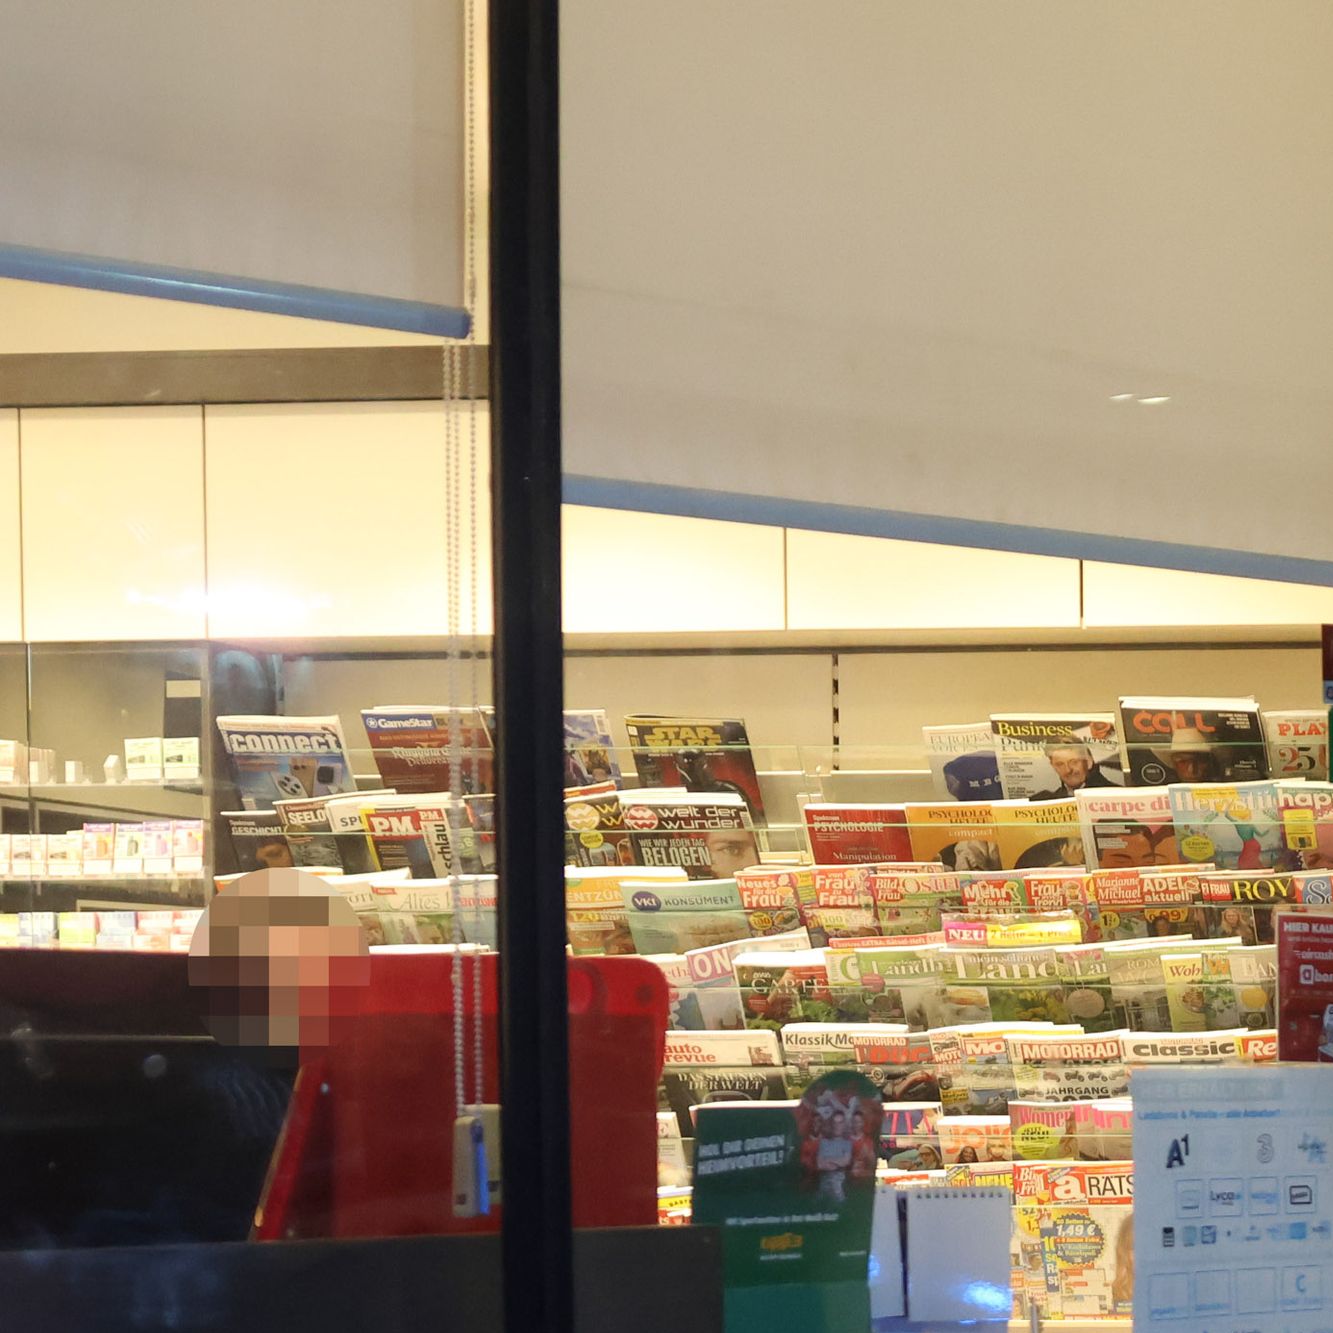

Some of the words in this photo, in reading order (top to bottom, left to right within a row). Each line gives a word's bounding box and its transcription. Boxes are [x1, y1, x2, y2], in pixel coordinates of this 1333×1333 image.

[377, 717, 434, 730] GameStar
[996, 720, 1074, 738] Business
[651, 726, 718, 741] STAR
[228, 731, 343, 755] connect
[658, 805, 701, 818] welt
[705, 805, 738, 818] der
[1088, 797, 1146, 816] carpe
[661, 818, 740, 830] wunder
[814, 822, 884, 833] PSYCHOLOGIE
[832, 850, 897, 861] Manipulation
[815, 874, 856, 890] Frau
[1142, 877, 1185, 892] ADEL
[1098, 887, 1142, 899] Michael
[1210, 883, 1230, 896] FRAU
[664, 895, 736, 906] KONSUMENT
[743, 891, 783, 908] Frau
[1143, 891, 1189, 903] aktuell
[948, 929, 985, 940] NEU
[663, 1042, 703, 1054] auto
[852, 1036, 907, 1047] MOTORRAD
[1021, 1041, 1121, 1060] MOTORRAD
[1132, 1040, 1236, 1057] Classic
[664, 1053, 717, 1063] revue
[1044, 1086, 1110, 1096] JAHRGANG
[1166, 1133, 1191, 1169] A1
[1056, 1224, 1085, 1237] 1,49
[1086, 1224, 1096, 1236] €
